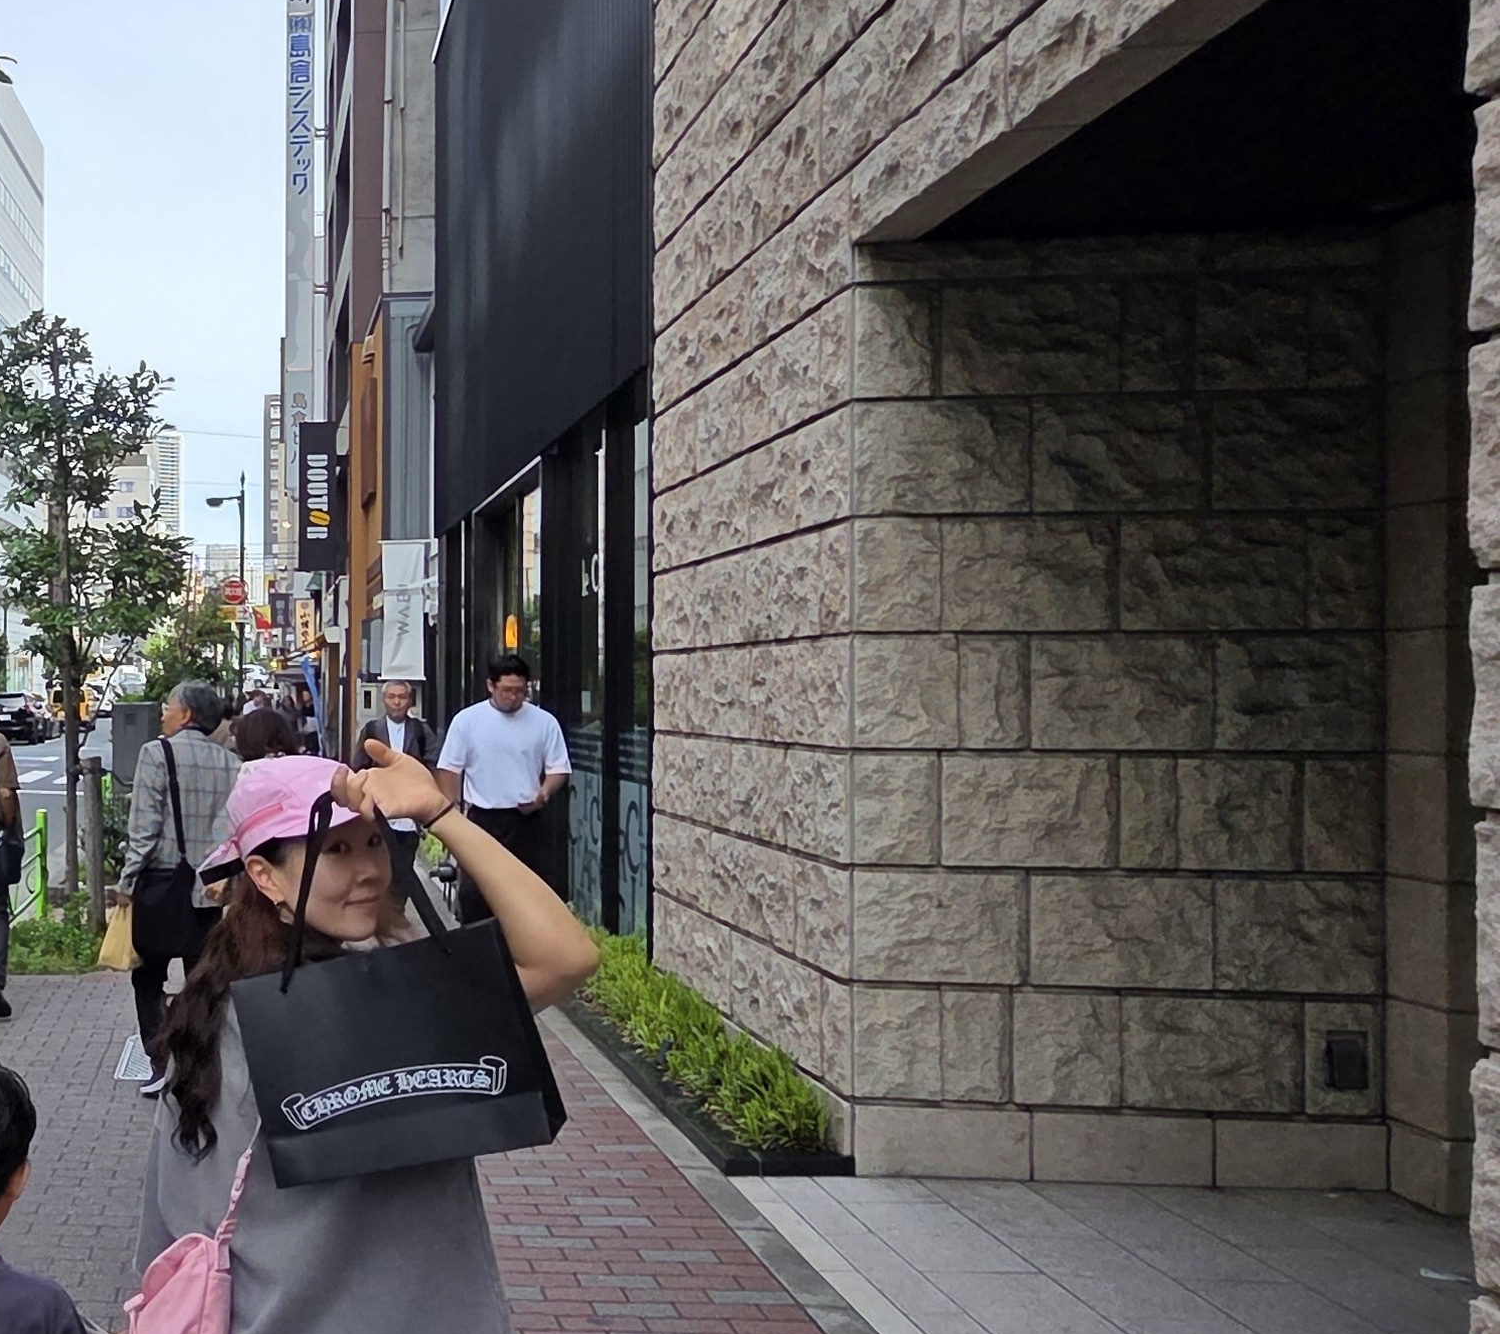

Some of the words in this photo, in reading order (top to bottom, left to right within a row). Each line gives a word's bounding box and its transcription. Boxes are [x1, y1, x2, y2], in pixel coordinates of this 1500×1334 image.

[306, 454, 331, 539] DOUTOR
[301, 1076, 394, 1121] CHROME
[394, 1069, 492, 1094] HEARTS
